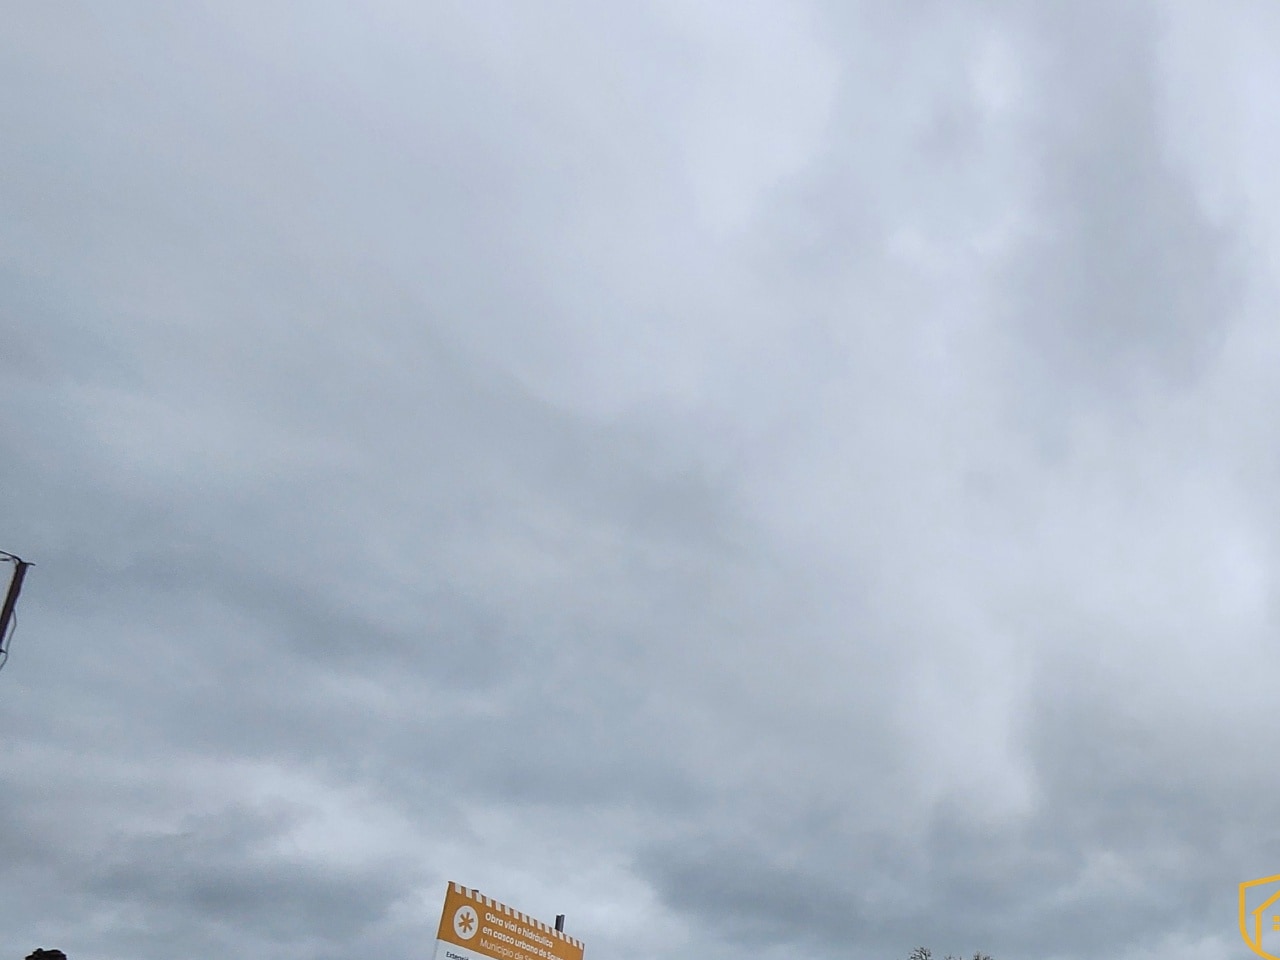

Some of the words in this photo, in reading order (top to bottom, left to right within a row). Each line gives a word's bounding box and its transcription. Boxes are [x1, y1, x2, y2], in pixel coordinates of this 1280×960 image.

[482, 926, 493, 936] en
[493, 931, 514, 944] casco
[515, 939, 538, 954] urbano
[538, 948, 547, 958] de
[485, 912, 504, 926] Obra
[517, 927, 522, 935] e
[522, 927, 553, 948] hidráulica
[479, 938, 514, 958] Municipio
[514, 952, 524, 960] de
